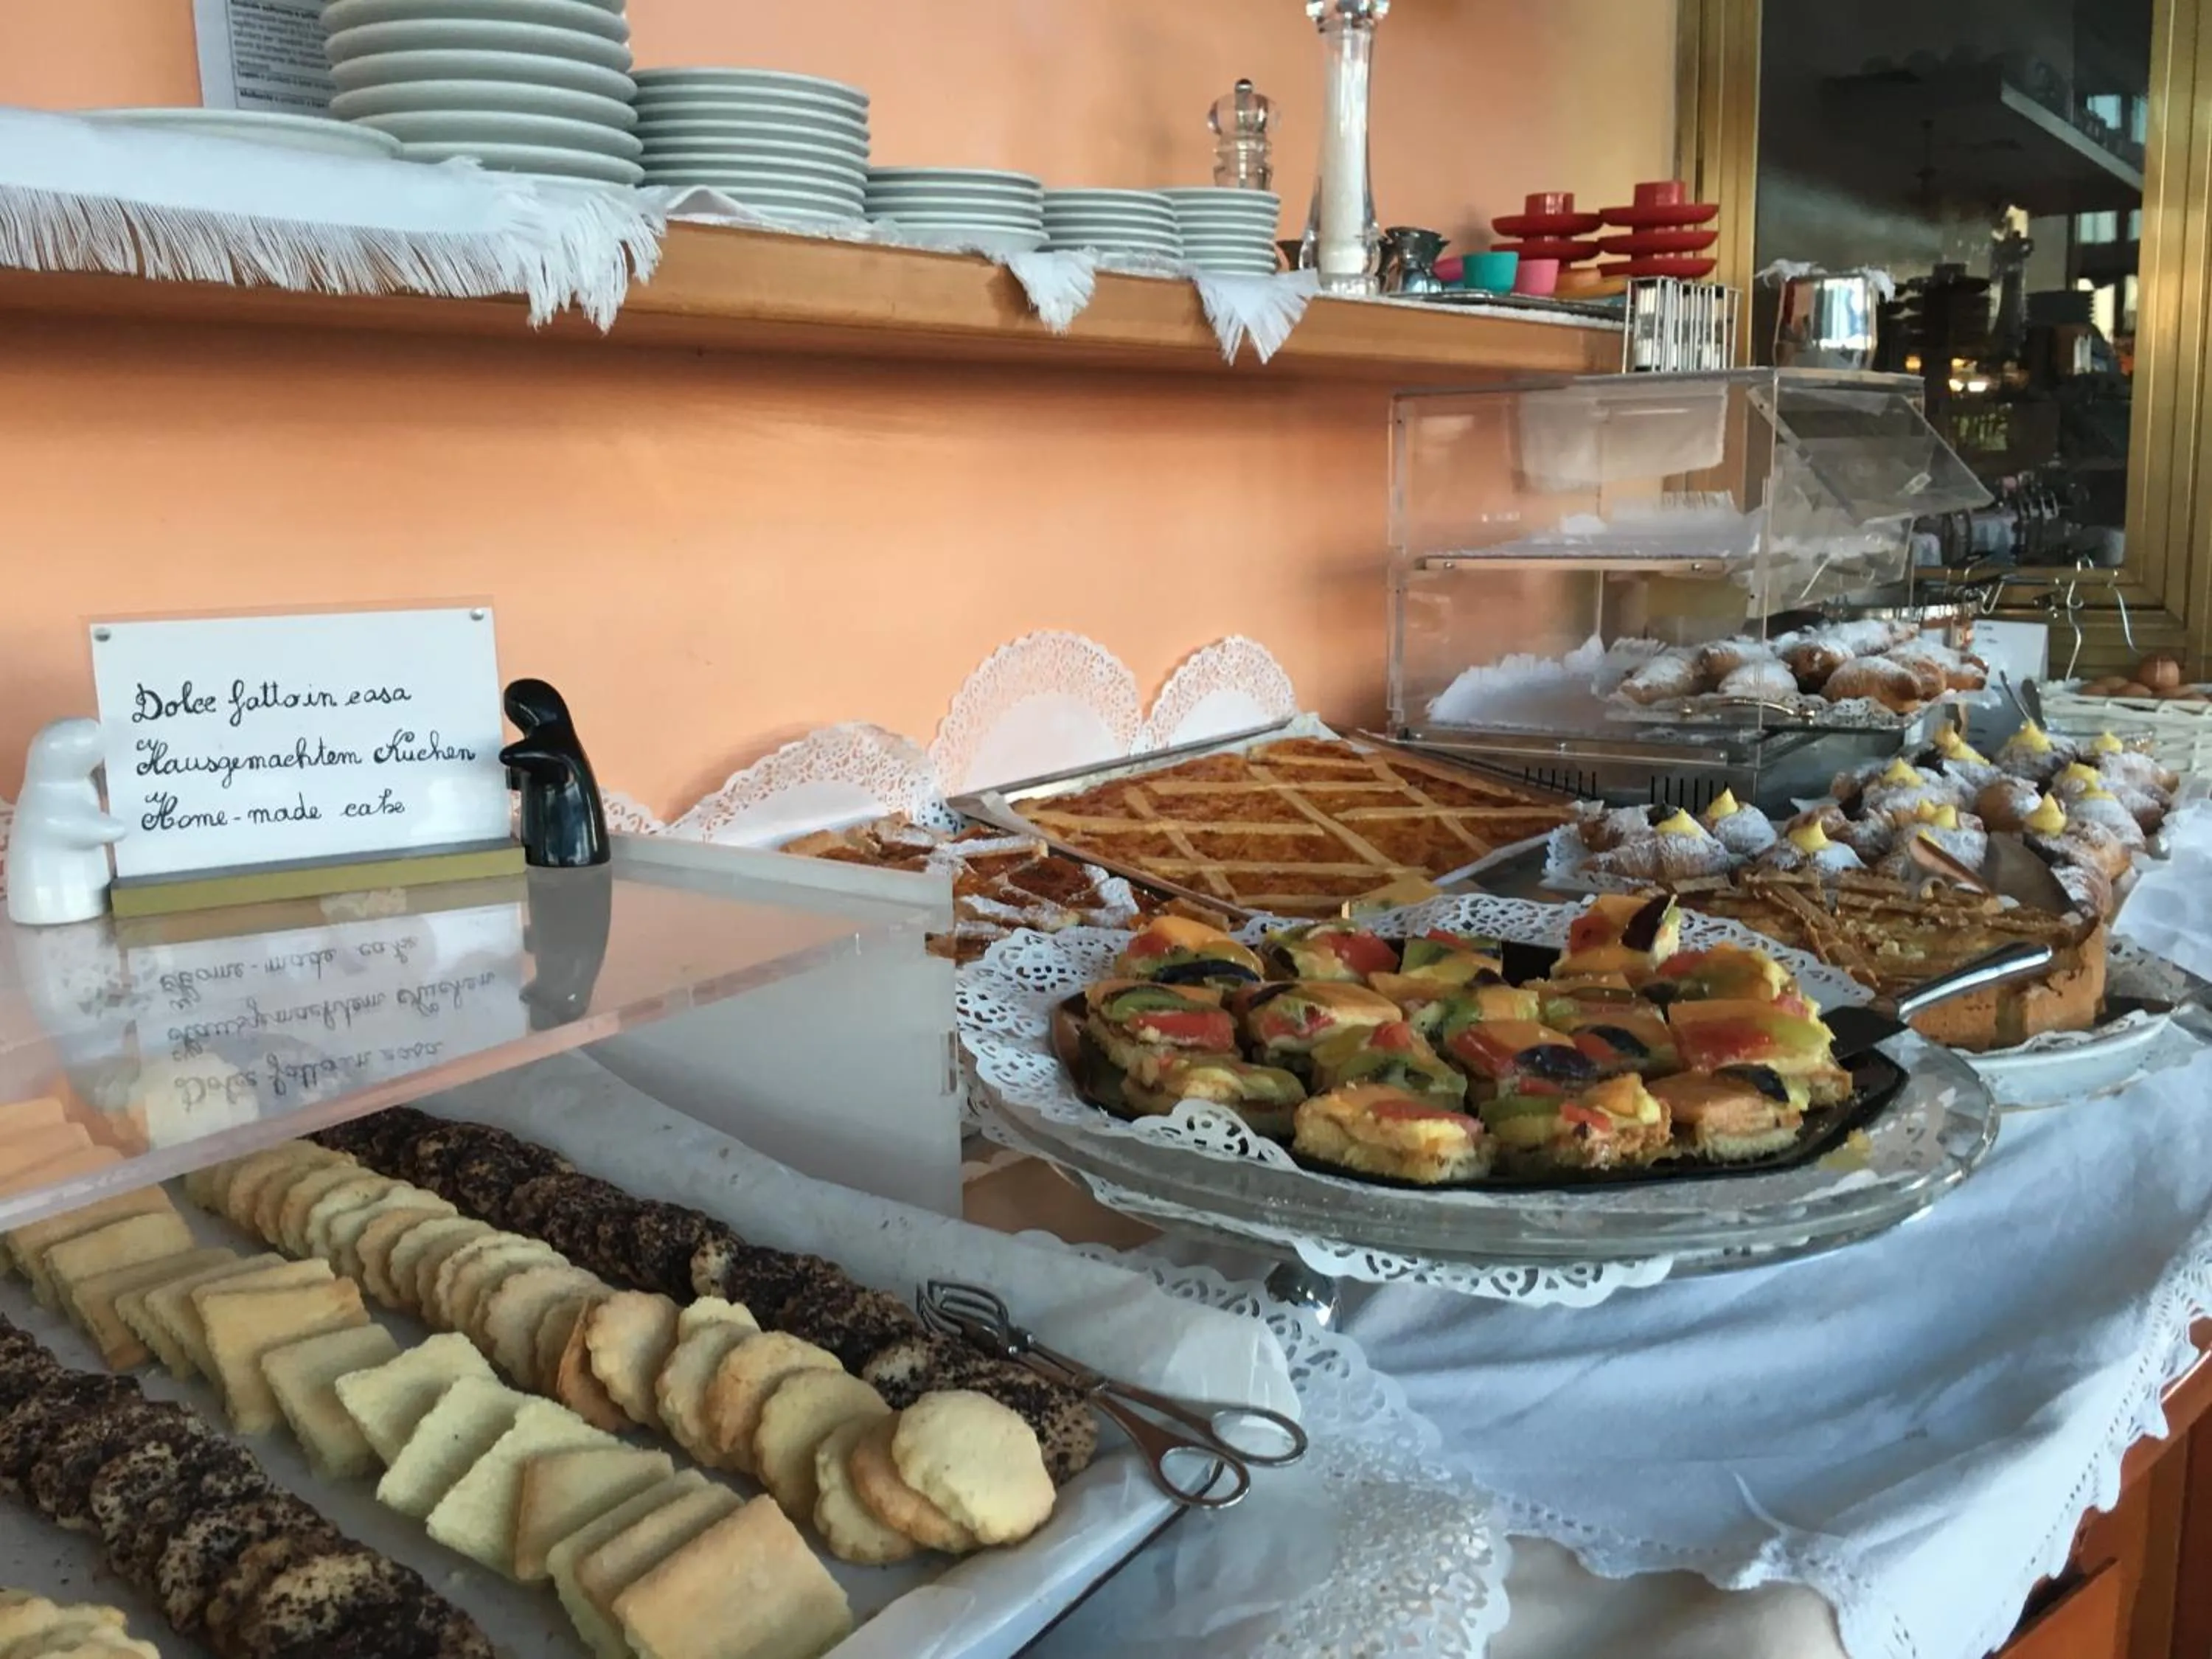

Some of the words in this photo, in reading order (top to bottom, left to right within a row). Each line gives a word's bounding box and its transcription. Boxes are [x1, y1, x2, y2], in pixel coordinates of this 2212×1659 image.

[132, 681, 217, 723] Dolce
[136, 737, 362, 789] Hausgemachtem
[340, 789, 406, 817] cake
